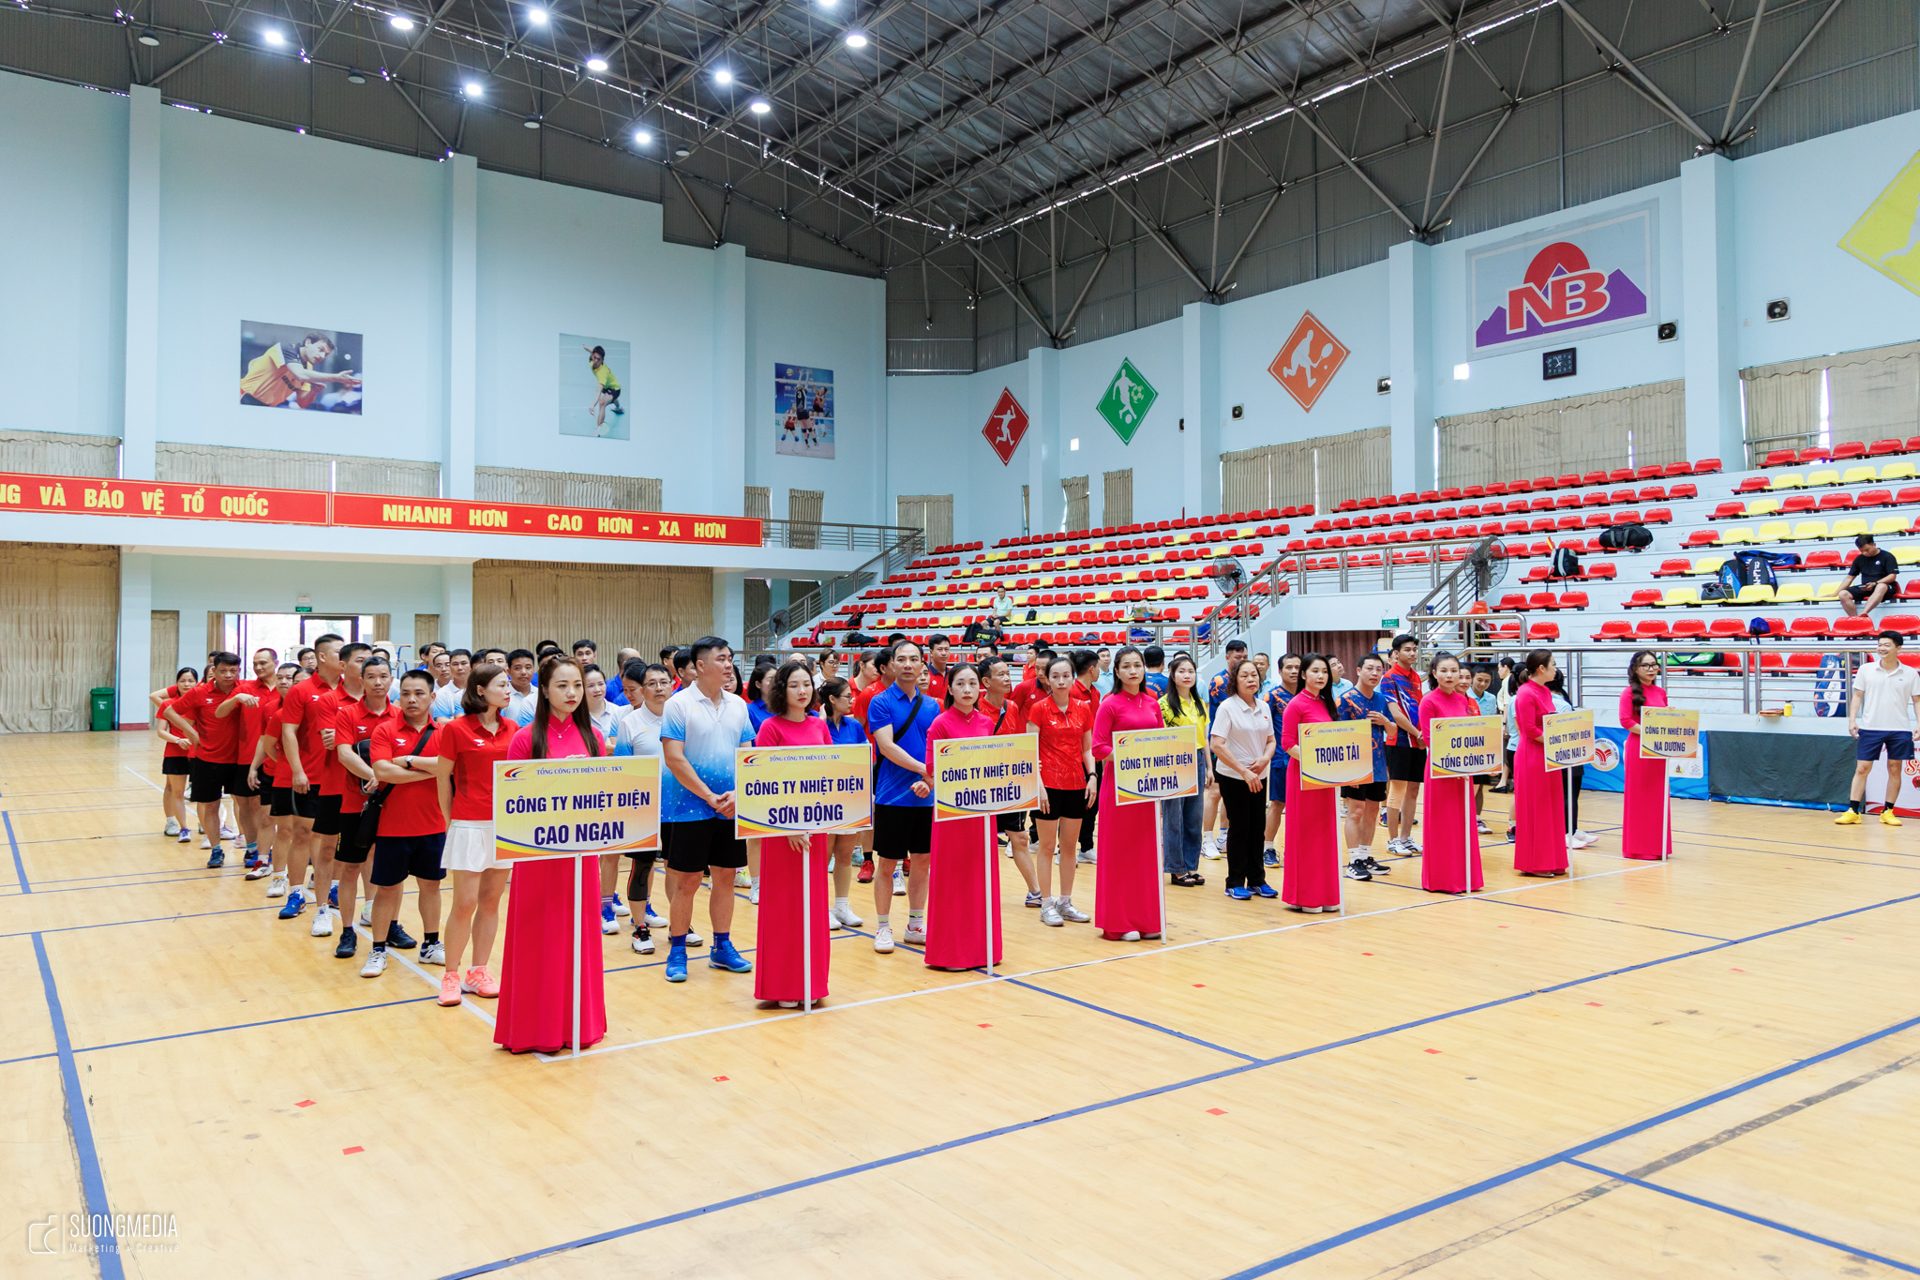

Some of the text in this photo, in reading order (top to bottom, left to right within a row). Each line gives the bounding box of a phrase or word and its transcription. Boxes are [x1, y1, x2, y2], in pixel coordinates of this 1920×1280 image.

[1507, 271, 1609, 333] NB
[40, 483, 66, 507] VÀ
[84, 482, 124, 509] BẢO
[141, 488, 164, 515] VỆ
[181, 487, 206, 513] TỔ
[220, 491, 269, 517] QUỐC
[382, 503, 452, 525] NHANH
[469, 508, 508, 528] HƠN
[547, 513, 583, 532] CAO
[598, 516, 633, 534] HƠN
[659, 520, 681, 537] XA
[694, 521, 727, 539] HƠN
[1562, 734, 1568, 743] TY
[1645, 725, 1659, 735] CÔNG
[1660, 726, 1666, 735] TY
[1451, 736, 1484, 748] CƠ QUAN
[1654, 741, 1686, 752] NA DƯƠNG
[1120, 751, 1193, 771] CÔNG TY NHIỆT ĐIỆN
[1315, 746, 1344, 766] TRỌNG
[1440, 752, 1495, 768] TỔNG CÔNG TY
[1572, 747, 1582, 759] NAI
[1582, 746, 1586, 757] 5
[554, 767, 571, 775] CÔNG
[942, 760, 1033, 782] CÔNG TY NHIỆT ĐIỆN
[745, 775, 864, 796] CÔNG TY NHIỆT ĐIỆN
[505, 789, 650, 814] CÔNG TY NHIỆT ĐIỆN
[955, 787, 986, 807] ĐÔNG
[768, 801, 843, 825] SƠN ĐỘNG
[534, 820, 624, 846] CAO NGẠN
